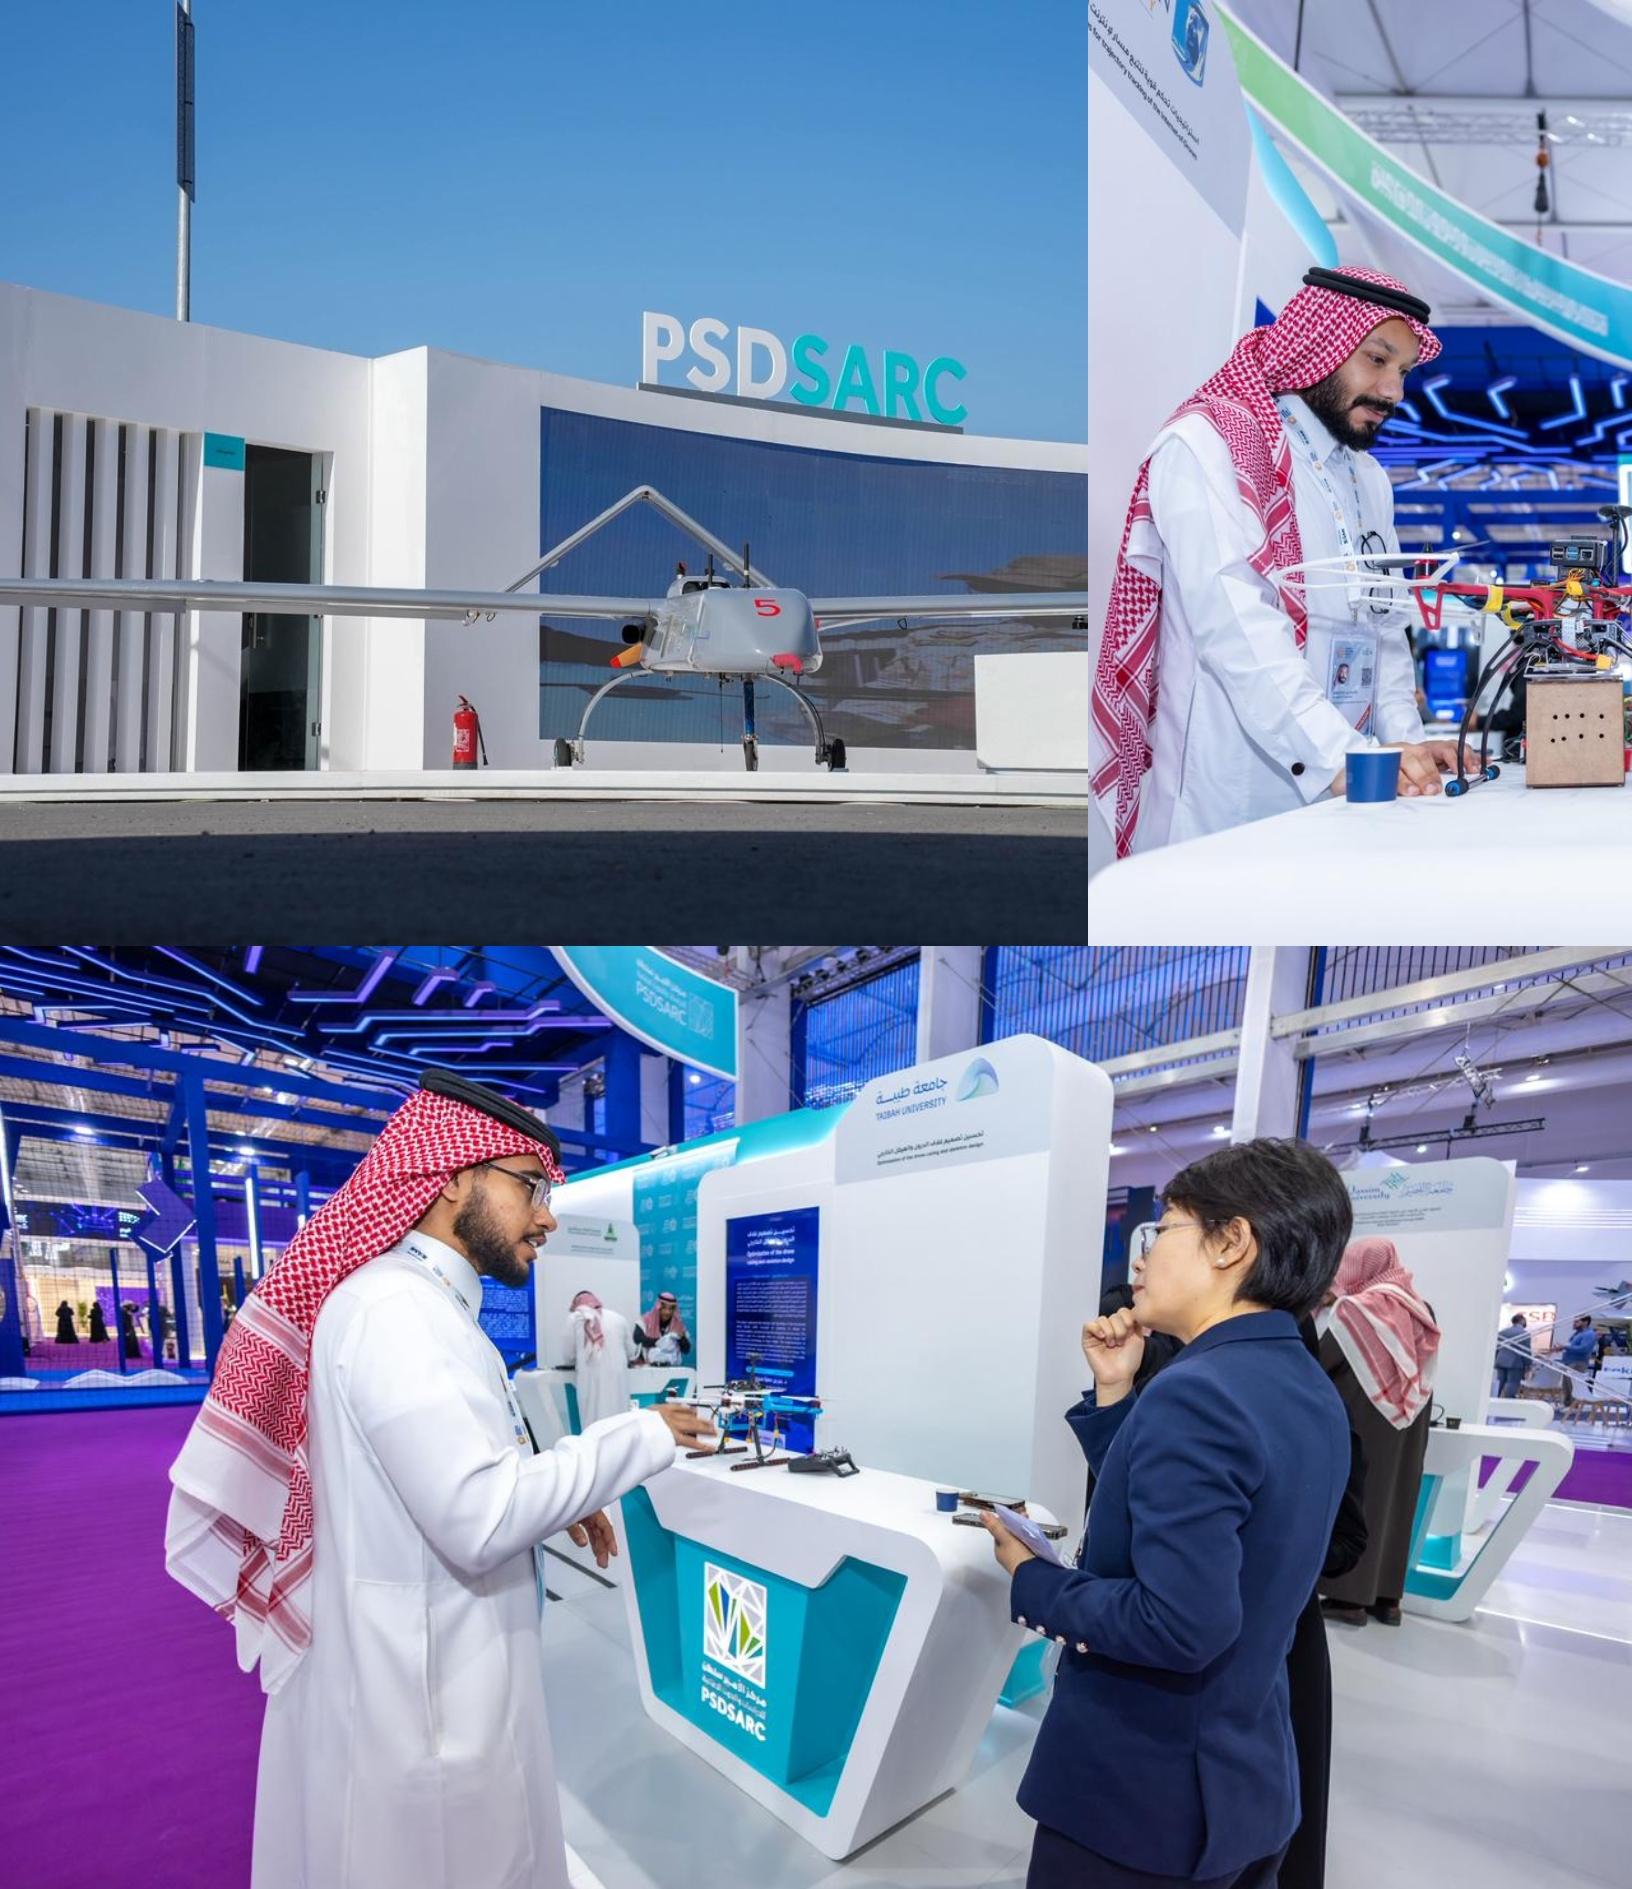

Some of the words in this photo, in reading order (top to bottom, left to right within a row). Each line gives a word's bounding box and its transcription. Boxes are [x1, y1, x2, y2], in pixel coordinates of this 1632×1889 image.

[643, 311, 968, 425] PSDSARC
[754, 598, 781, 617] 5
[875, 1088, 911, 1105] طيبة
[913, 1077, 948, 1094] جامعة
[876, 1110, 900, 1121] TAIBAH
[902, 1096, 946, 1115] UNIVERSITY
[702, 1685, 767, 1741] PSDSARC
